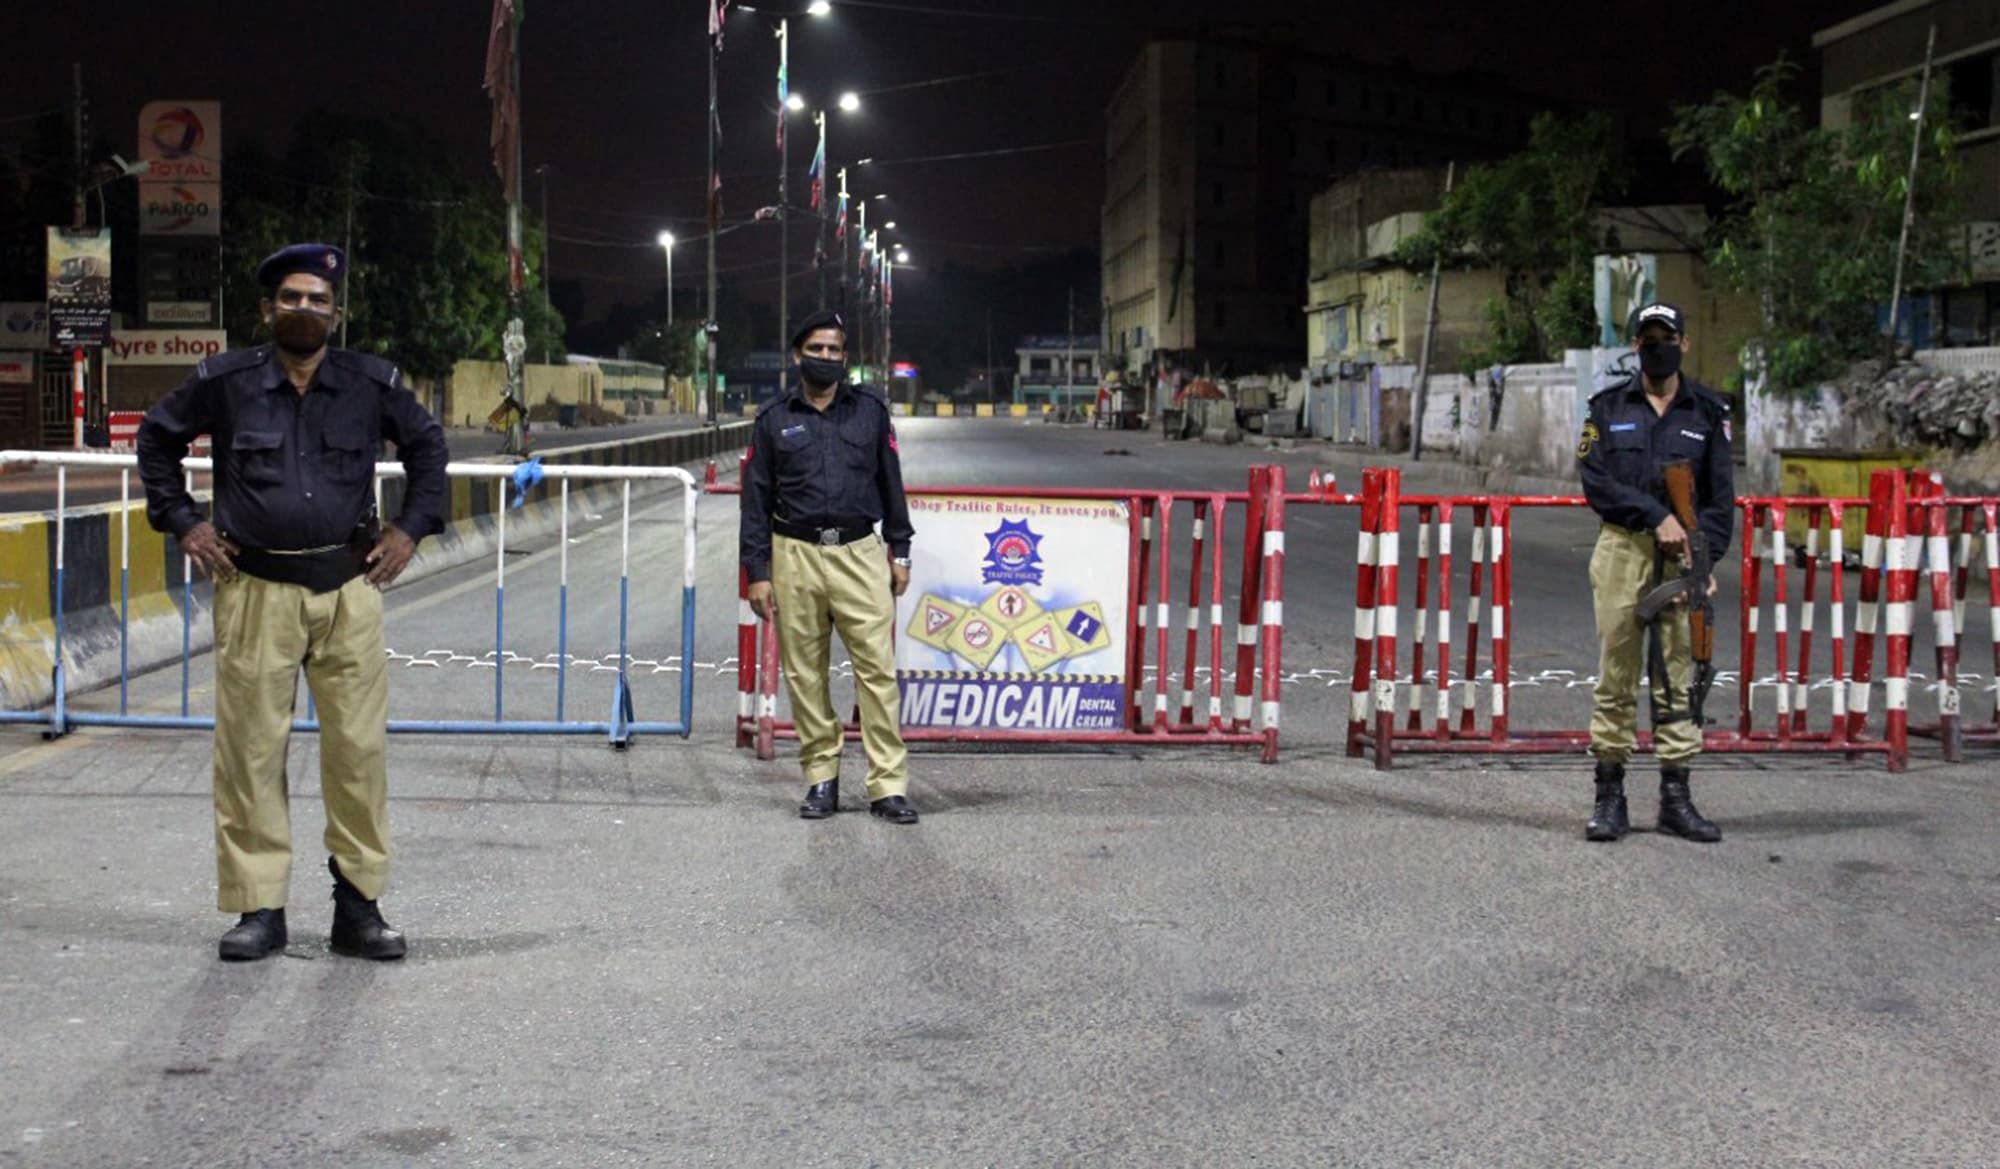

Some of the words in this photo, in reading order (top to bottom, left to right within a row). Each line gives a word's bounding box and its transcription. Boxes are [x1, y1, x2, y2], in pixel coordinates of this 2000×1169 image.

[148, 161, 212, 177] TOTAL
[149, 201, 209, 217] PARCO
[111, 338, 157, 362] tyre
[163, 335, 220, 359] shop
[946, 500, 991, 513] Traffic
[995, 502, 1036, 516] Rules,
[1055, 507, 1089, 517] saves
[1093, 507, 1121, 519] you.
[901, 683, 1080, 729] MEDICAM
[1079, 698, 1116, 711] DENTAL
[1075, 715, 1114, 728] CREAM
